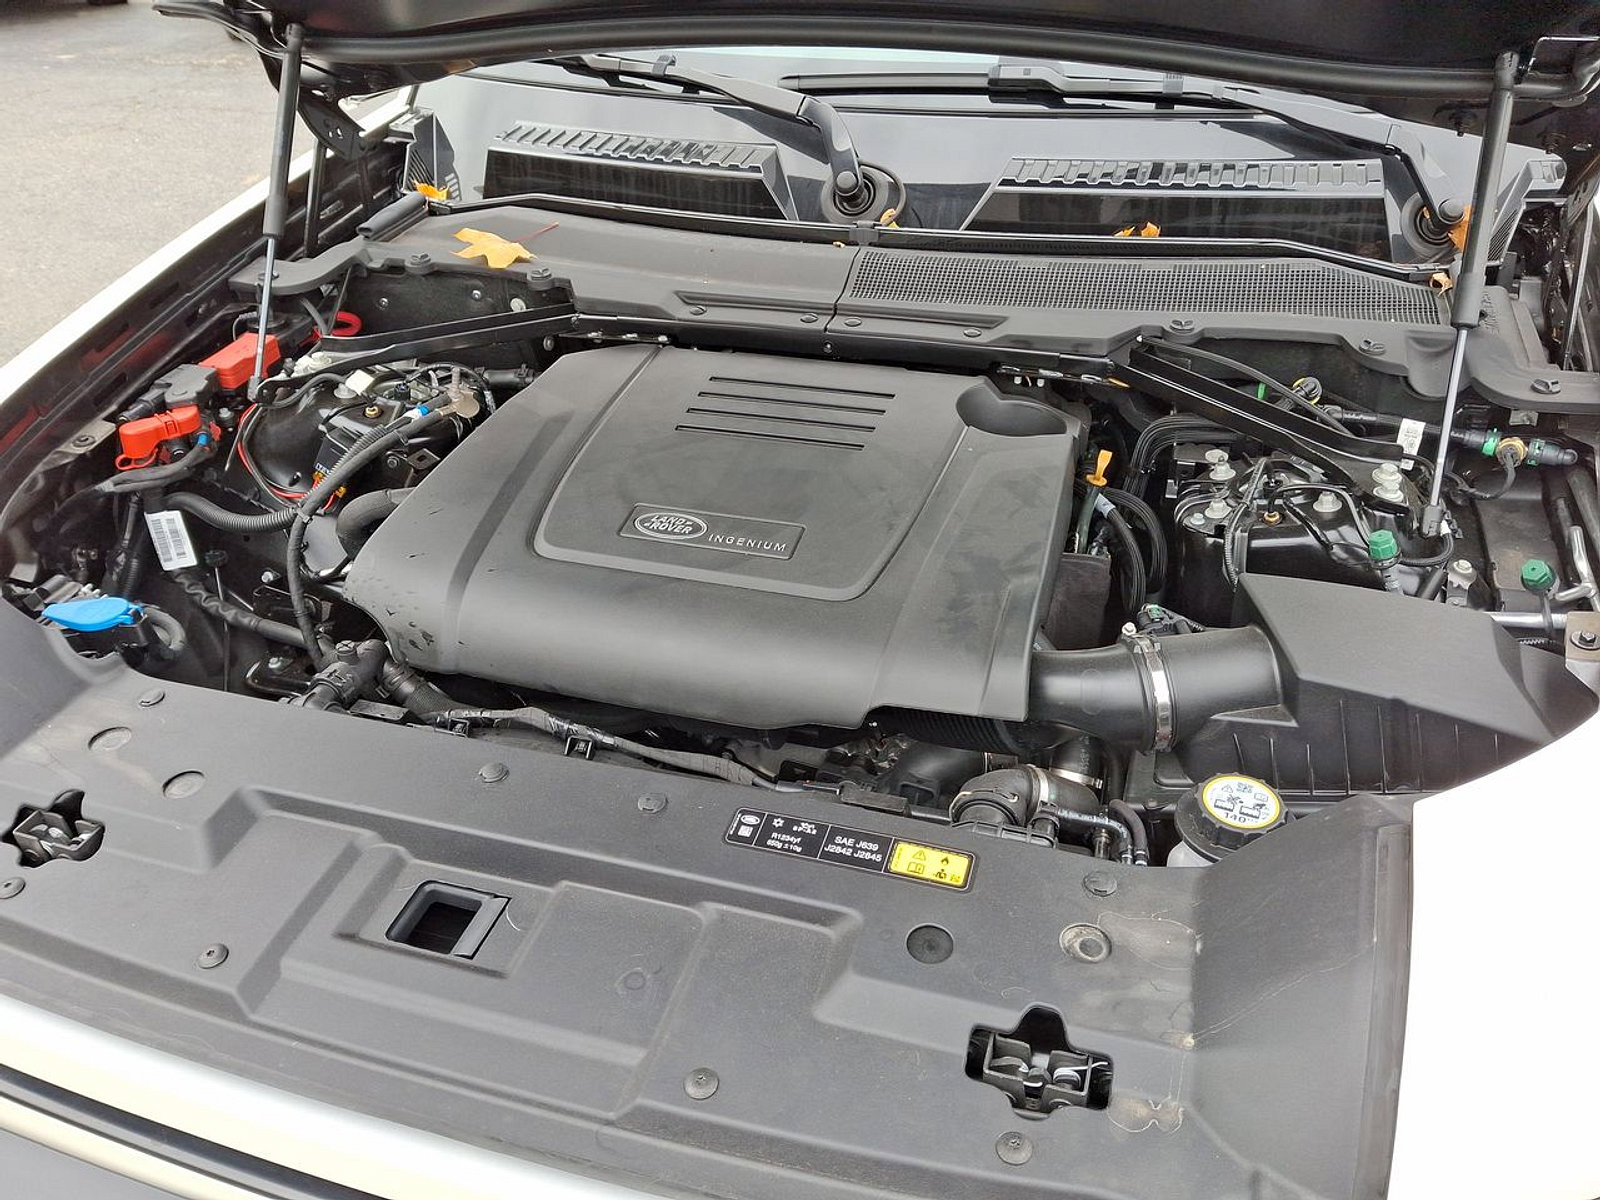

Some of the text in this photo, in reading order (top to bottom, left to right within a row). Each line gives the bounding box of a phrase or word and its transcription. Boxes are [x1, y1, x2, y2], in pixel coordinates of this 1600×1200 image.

[651, 515, 685, 526] LAND
[649, 522, 693, 535] ROVER
[708, 533, 787, 551] INGENIUM
[834, 836, 879, 851] SAE J639
[824, 844, 852, 856] J2842
[853, 849, 883, 862] J2845
